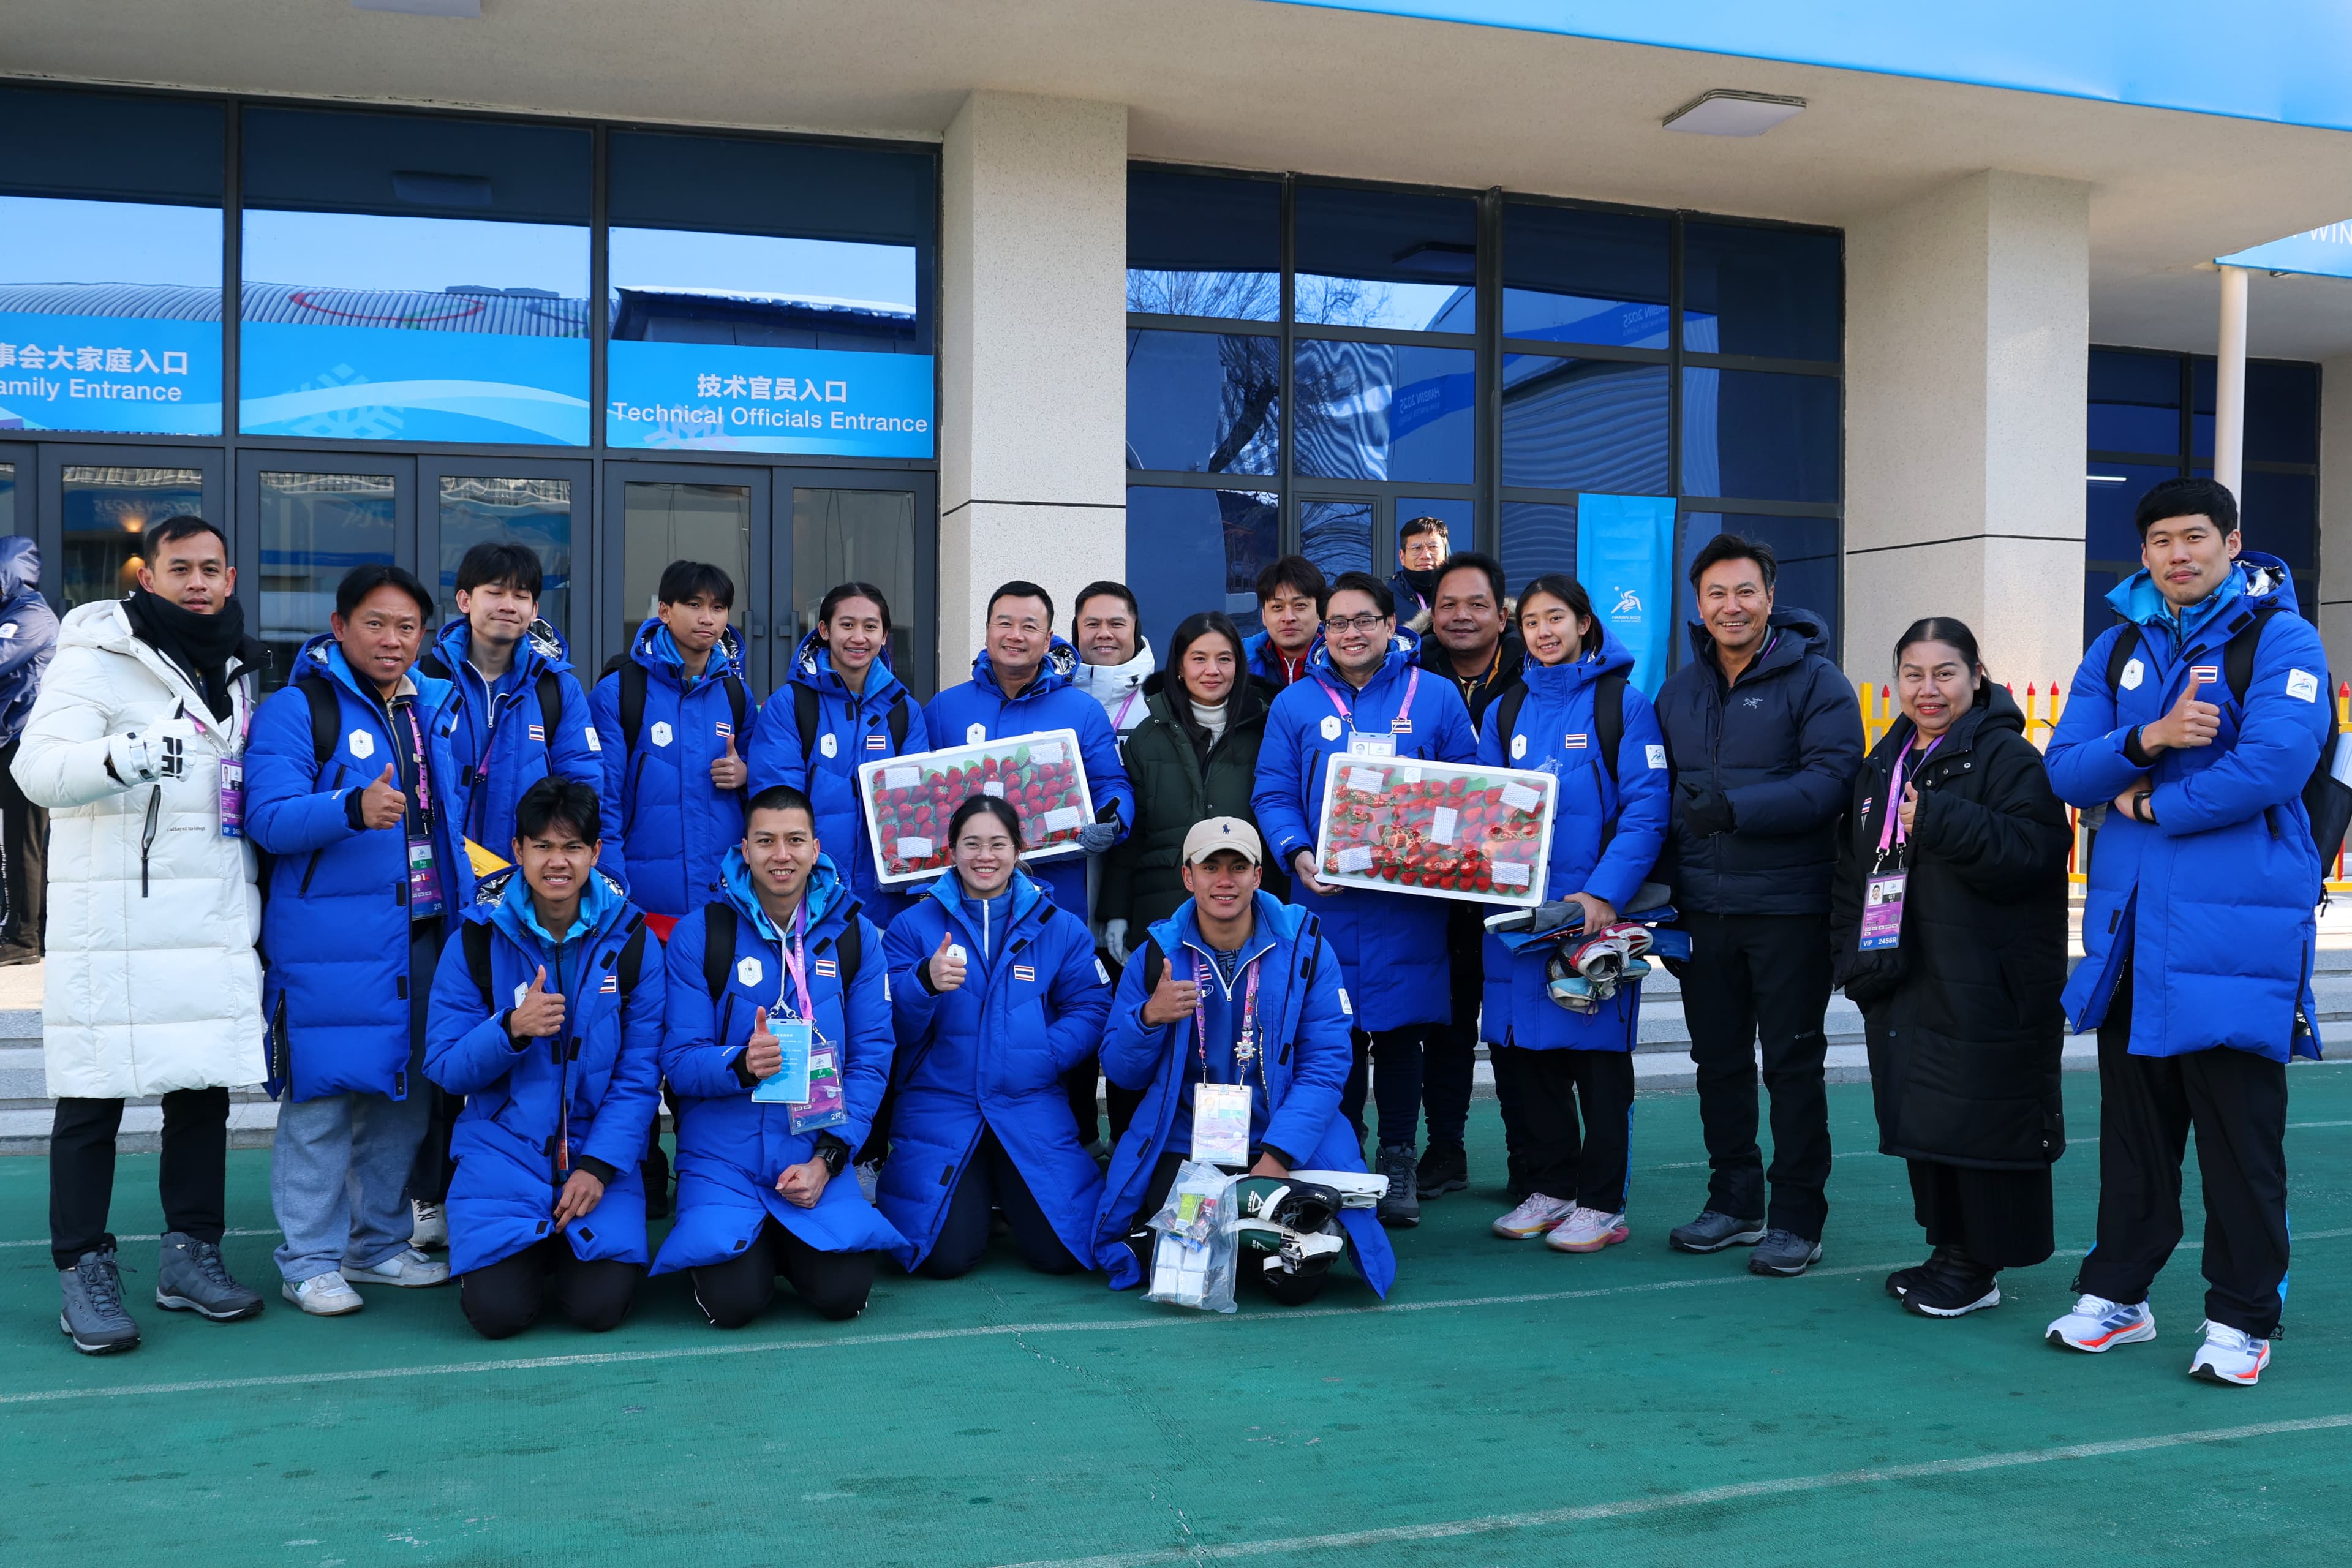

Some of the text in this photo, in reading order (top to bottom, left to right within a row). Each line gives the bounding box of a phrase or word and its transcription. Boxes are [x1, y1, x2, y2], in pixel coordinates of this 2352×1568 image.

[0, 342, 187, 375] 事会大家庭入口
[70, 379, 182, 401] Entrance
[698, 374, 846, 403] 技术官员入口
[612, 402, 928, 432] Technical Officials Entrance
